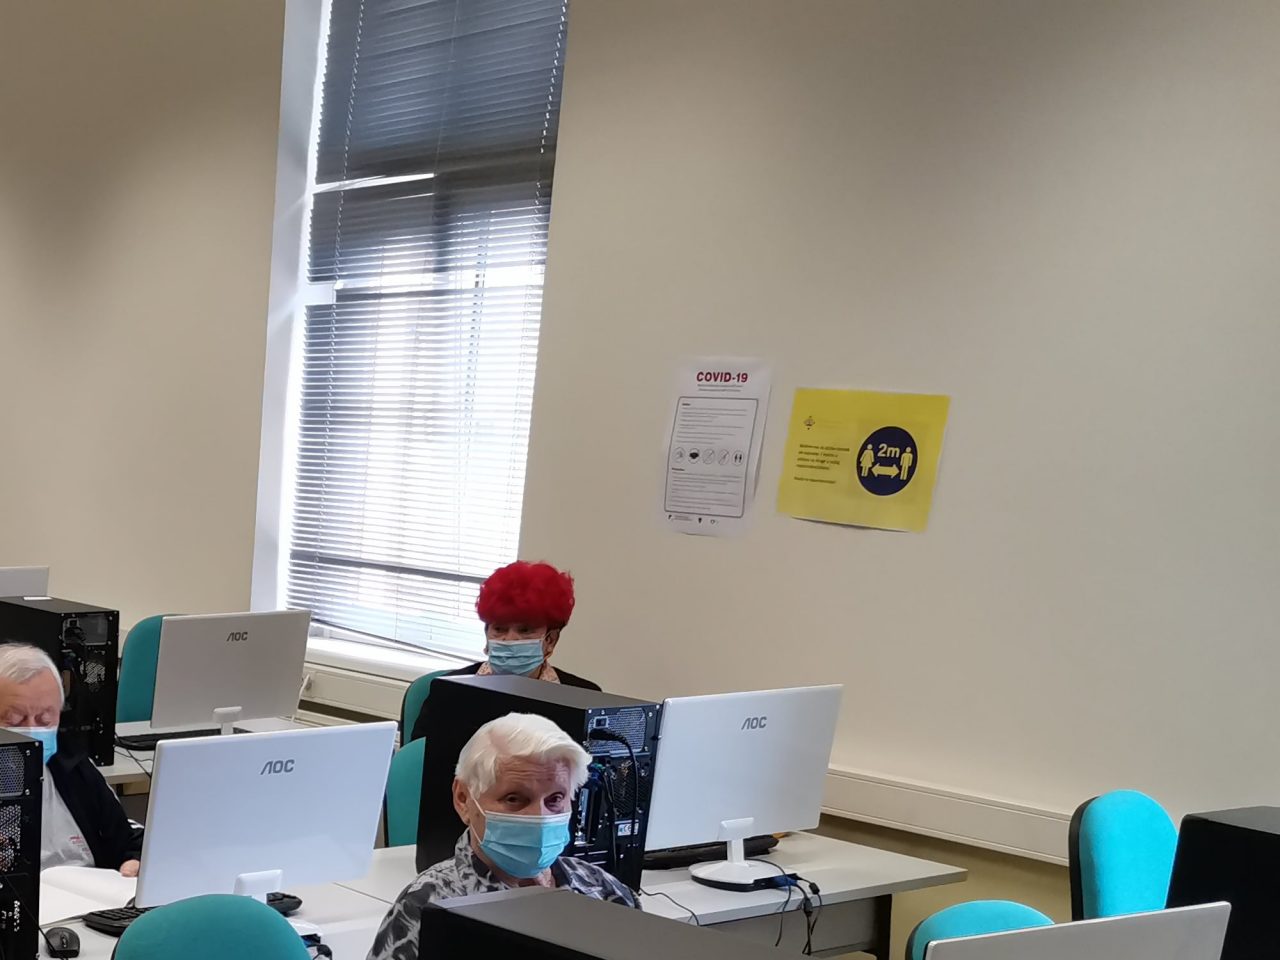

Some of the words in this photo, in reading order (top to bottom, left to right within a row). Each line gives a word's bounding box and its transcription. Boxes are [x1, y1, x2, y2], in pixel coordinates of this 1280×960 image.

[696, 371, 748, 383] COVID-19
[877, 443, 900, 458] 2m
[227, 631, 248, 642] AOC
[741, 716, 767, 729] AOC
[261, 759, 295, 776] AOC
